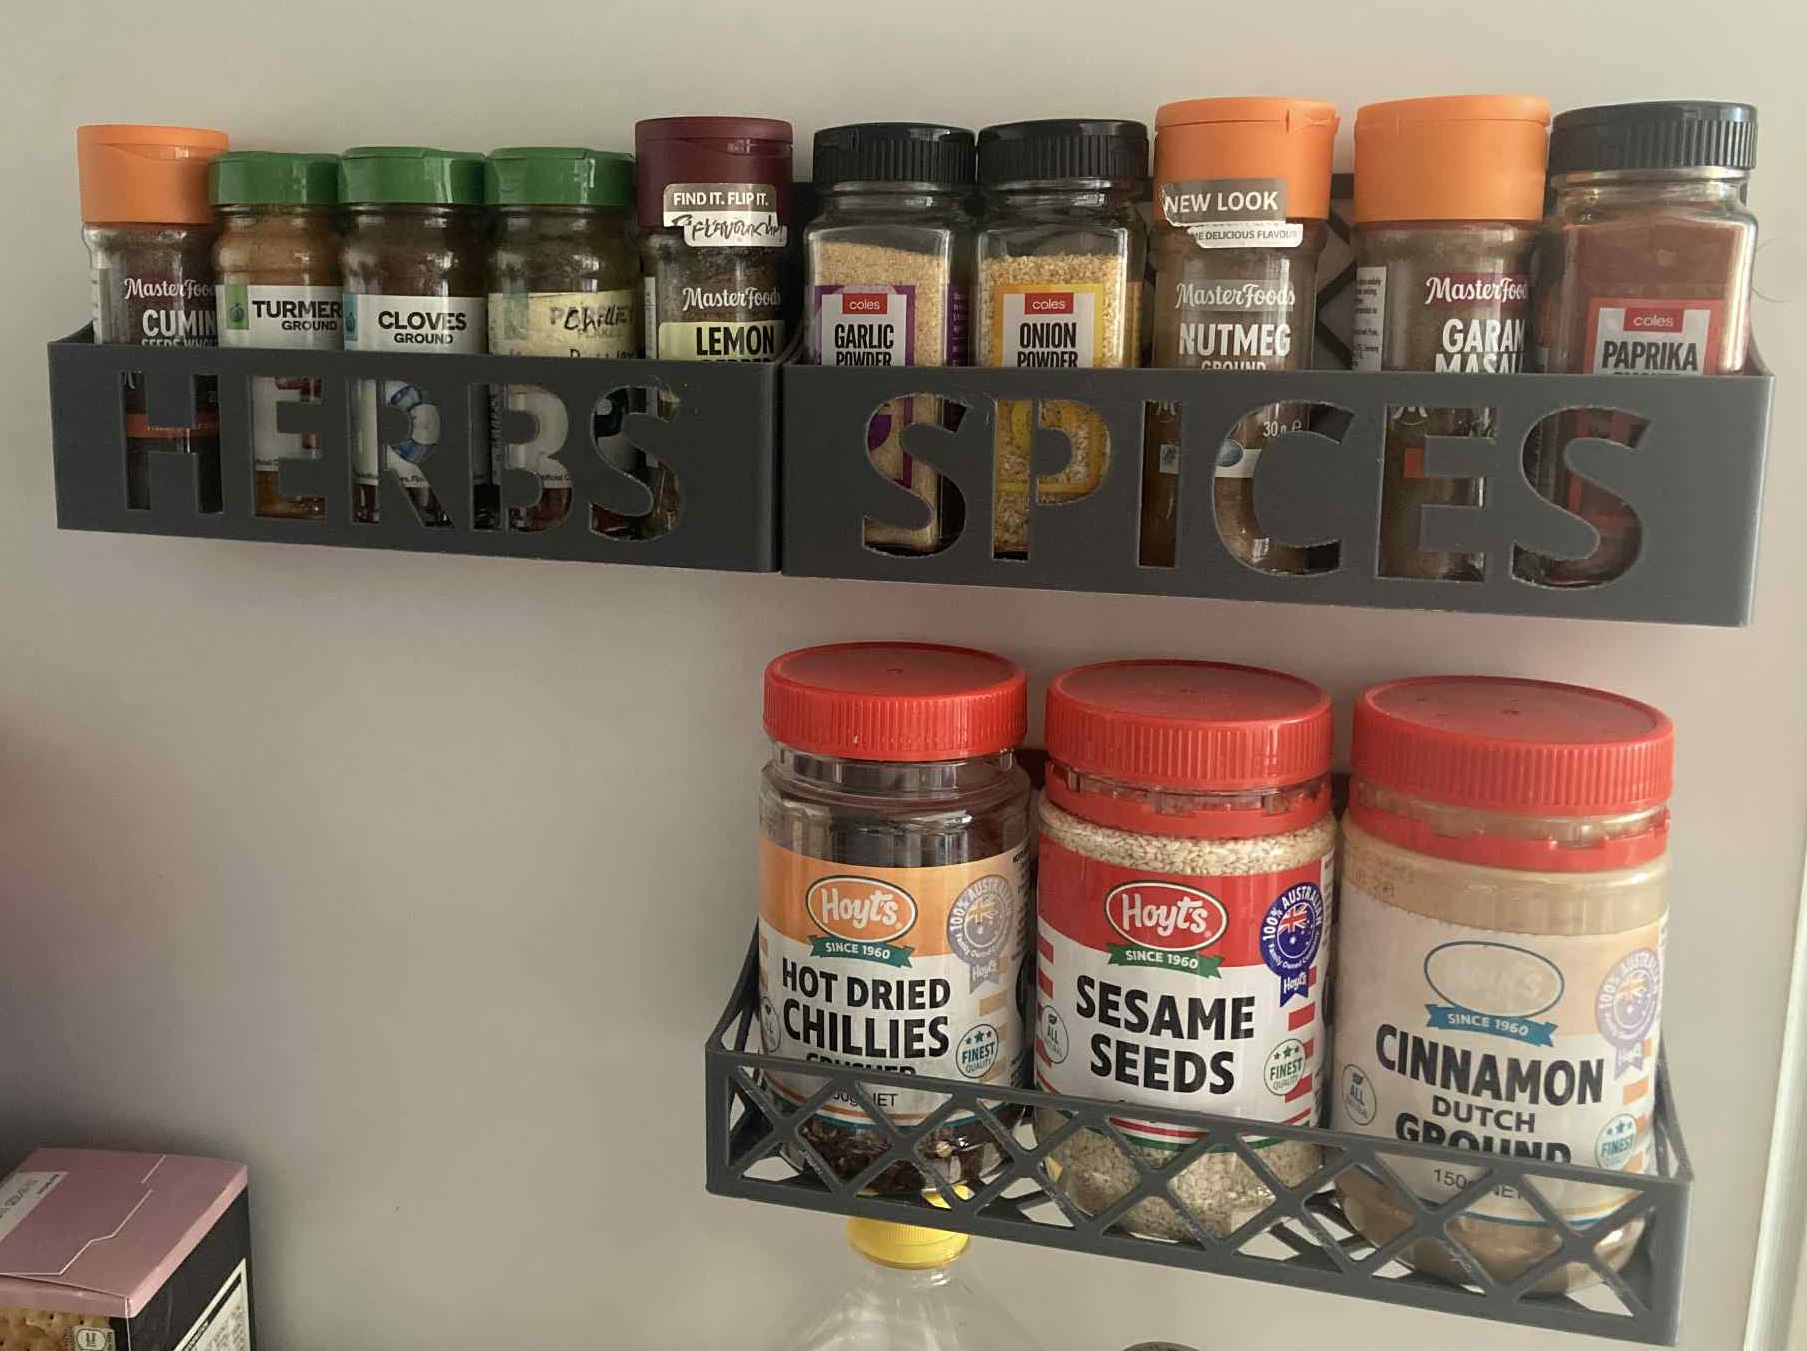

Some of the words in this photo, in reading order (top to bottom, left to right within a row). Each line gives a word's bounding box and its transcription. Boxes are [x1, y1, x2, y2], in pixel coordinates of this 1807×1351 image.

[673, 192, 706, 206] FIND
[709, 192, 725, 205] IT.
[727, 192, 755, 206] FLIP
[757, 192, 769, 206] IT.
[1165, 193, 1211, 213] NEW
[1217, 191, 1279, 211] LOOK
[1206, 230, 1255, 241] DELICIOUS
[849, 300, 881, 311] coles
[1032, 298, 1066, 310] coles
[1175, 283, 1295, 309] MasterFoods
[142, 309, 217, 337] CUMIN
[281, 320, 338, 331] GROUND
[378, 311, 467, 330] CLOVES
[1633, 314, 1674, 328] coles
[393, 333, 453, 344] GROUND
[696, 325, 775, 356] LEMON
[834, 323, 895, 349] GARLIC
[1020, 322, 1077, 348] ONION
[1179, 323, 1291, 357] NUTMEG
[1602, 341, 1698, 371] PAPRIKA
[119, 369, 682, 541] HERBS
[862, 392, 1653, 590] SPICES
[822, 888, 898, 930] Hoyt's
[1122, 893, 1208, 937] Hoyt's
[1263, 906, 1283, 941] 100%
[825, 942, 859, 954] SINCE
[862, 945, 891, 959] 1960
[1125, 950, 1163, 963] SINCE
[1167, 953, 1199, 969] 1960
[782, 958, 838, 1005] HOT
[847, 976, 951, 1012] DRIED
[1076, 974, 1256, 1041] SESAME
[783, 998, 949, 1058] CHILLIES
[1447, 1013, 1490, 1027] SINCE
[1494, 1019, 1529, 1036] 1960
[962, 1041, 996, 1064] FINEST
[1090, 1033, 1235, 1094] SEEDS
[1375, 1023, 1605, 1106] CINNAMON
[1270, 1057, 1303, 1081] FINEST
[1432, 1095, 1536, 1133] DUTCH
